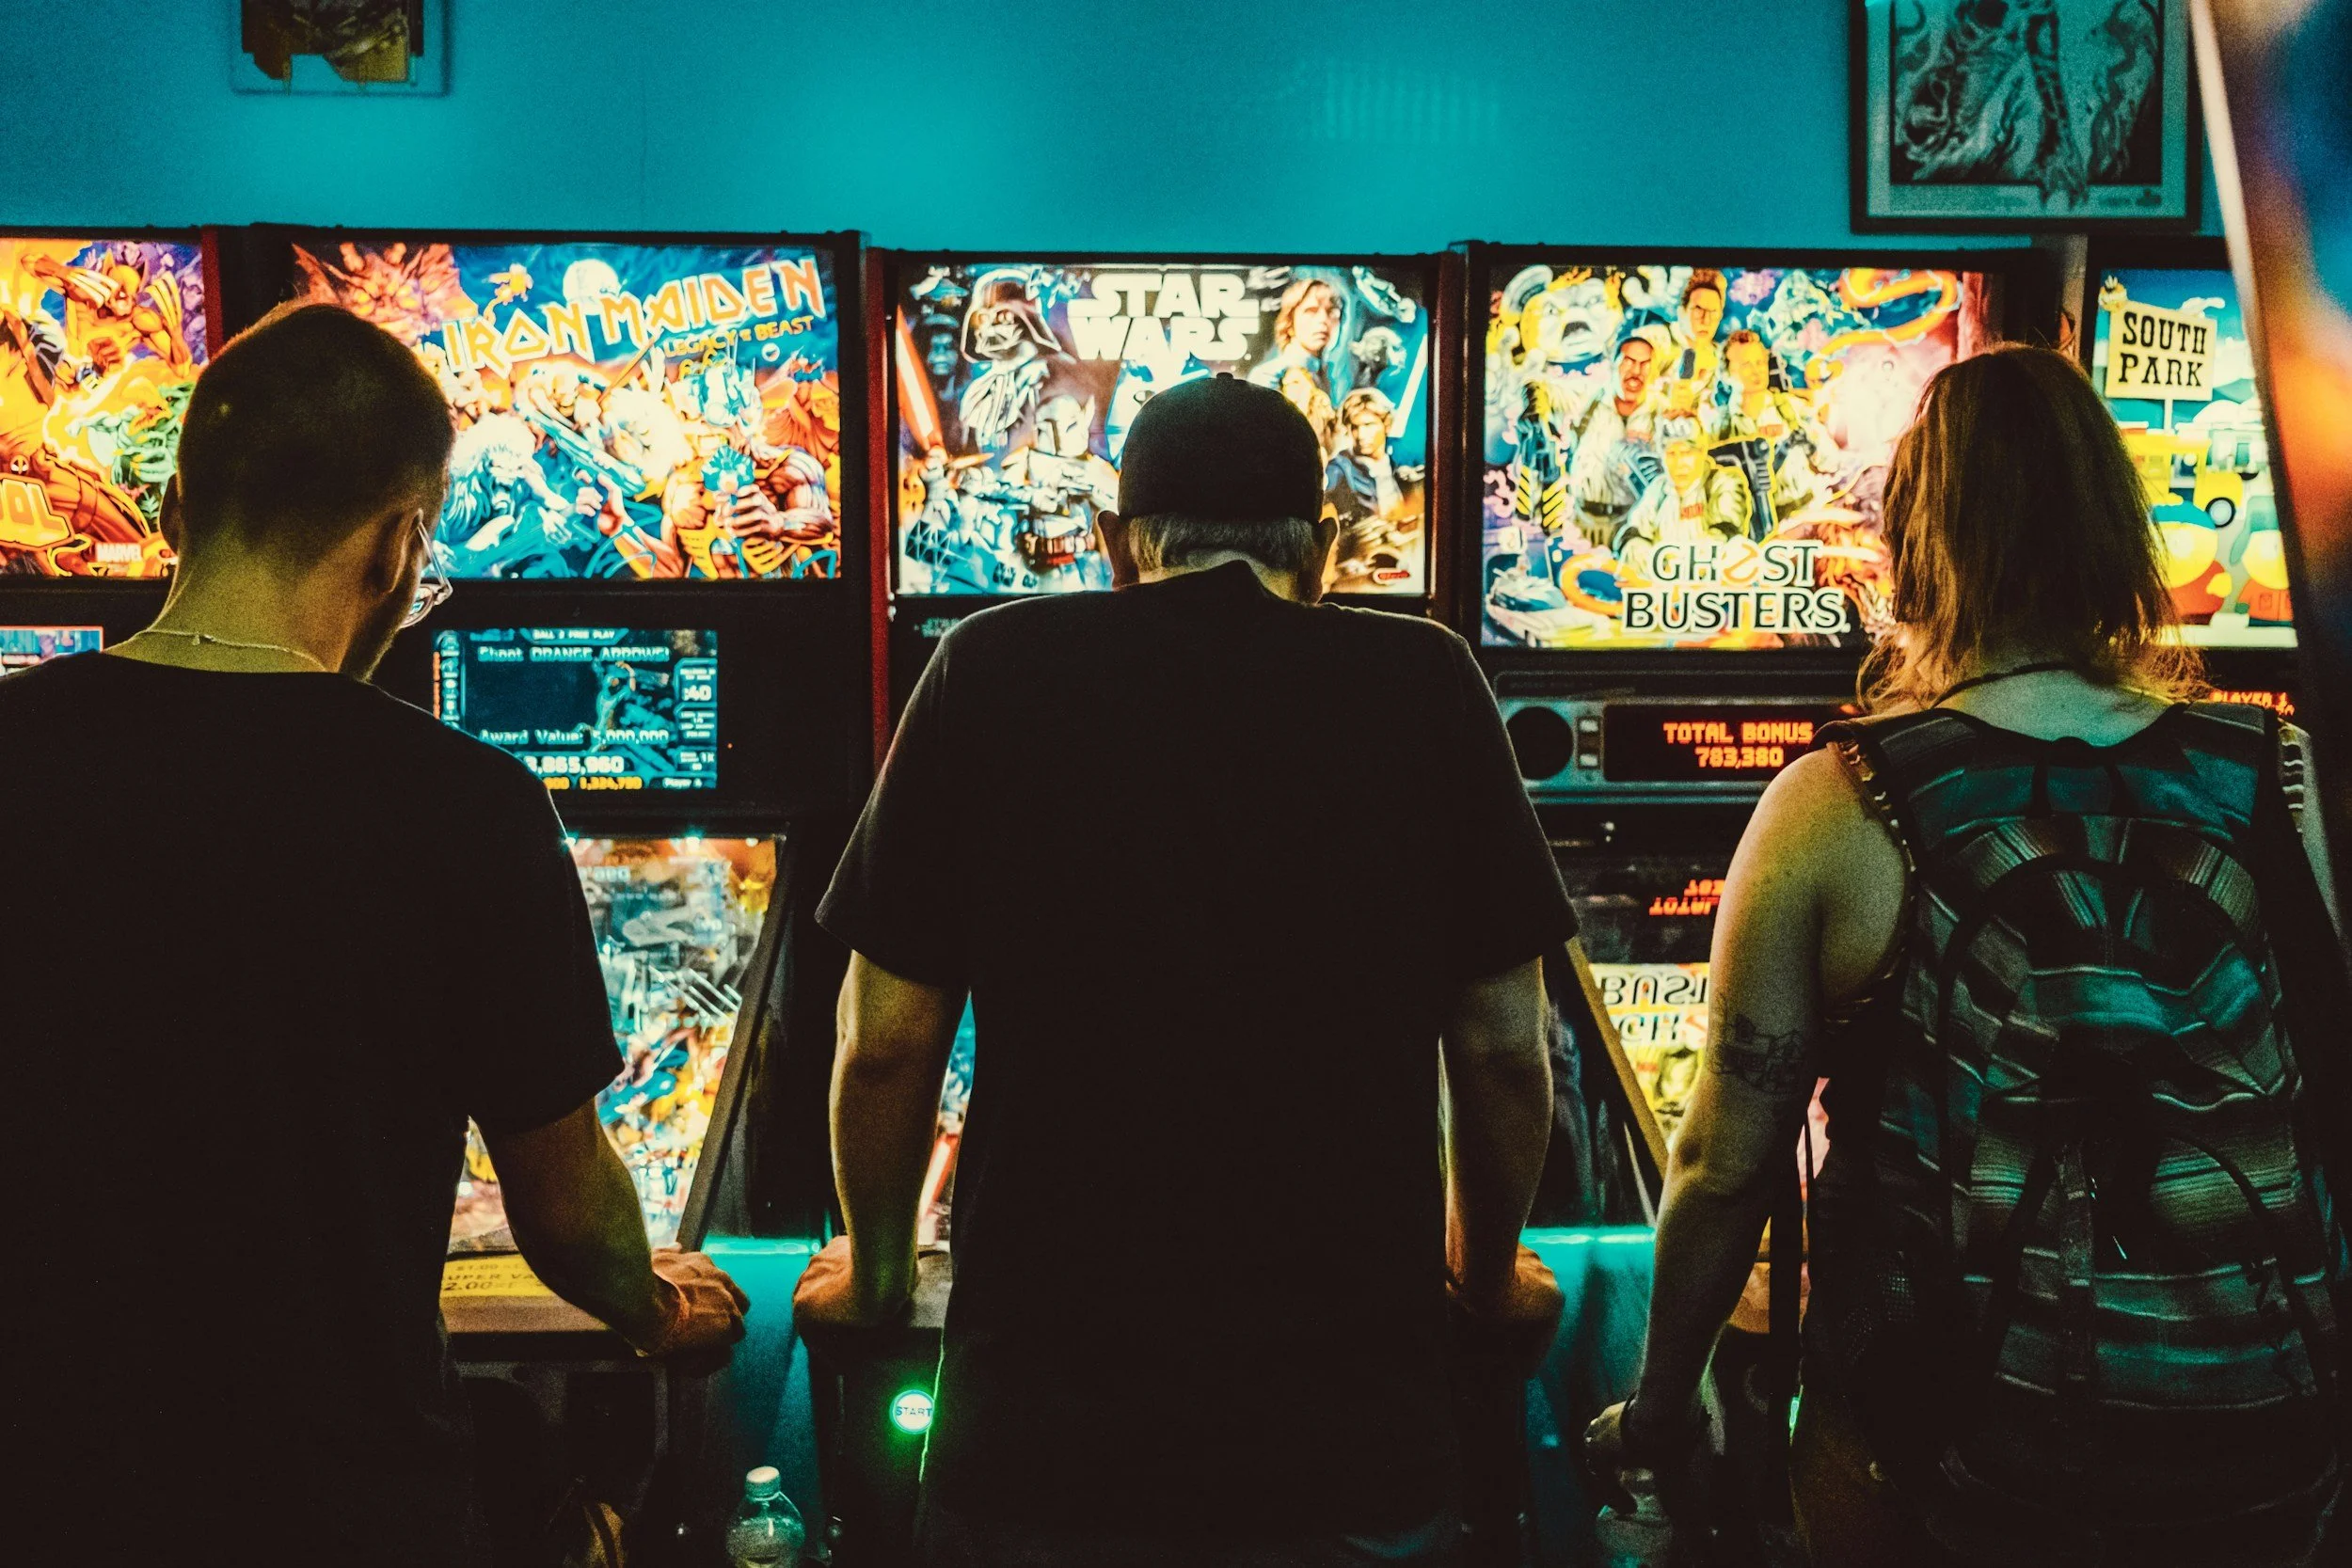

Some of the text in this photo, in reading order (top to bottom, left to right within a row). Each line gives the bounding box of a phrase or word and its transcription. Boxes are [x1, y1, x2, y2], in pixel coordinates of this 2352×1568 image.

[1067, 273, 1259, 318] STAR
[442, 255, 826, 379] IRON MAIDEN
[662, 328, 738, 358] LEGACY
[754, 315, 815, 341] BEAST
[2122, 311, 2208, 356] SOUTH
[1066, 316, 1260, 361] WARS
[2118, 352, 2202, 388] PARK
[0, 476, 71, 547] OL
[1625, 591, 1844, 630] BUSTERS
[479, 729, 529, 744] Award
[534, 729, 584, 744] Value:
[1662, 722, 1814, 745] TOTAL BONUS
[1694, 746, 1784, 768] 783,380
[896, 1405, 933, 1418] START
